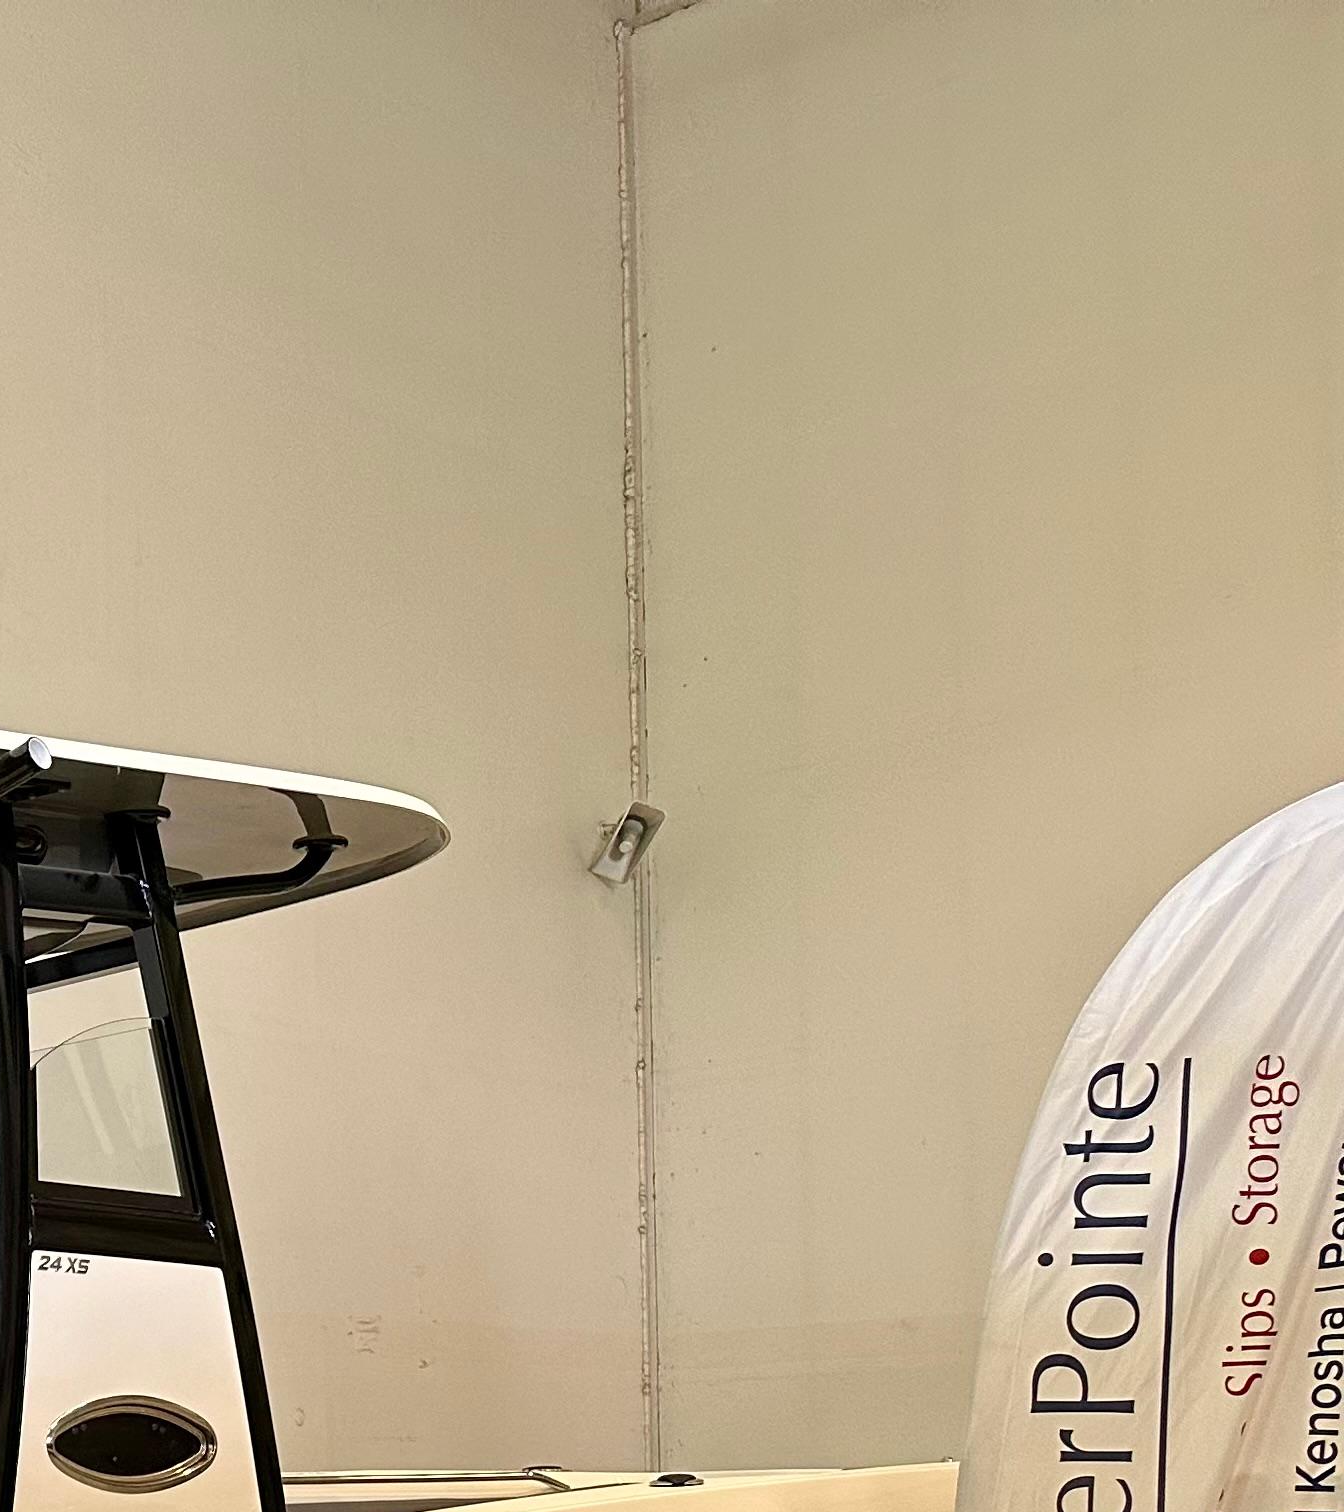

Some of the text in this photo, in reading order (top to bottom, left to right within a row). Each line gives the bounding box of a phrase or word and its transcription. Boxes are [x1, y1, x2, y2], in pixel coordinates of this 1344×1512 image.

[1232, 1054, 1301, 1226] Storage
[38, 1255, 91, 1274] 24 XS
[1222, 1288, 1278, 1397] Slips
[1295, 1307, 1344, 1493] Kenosha
